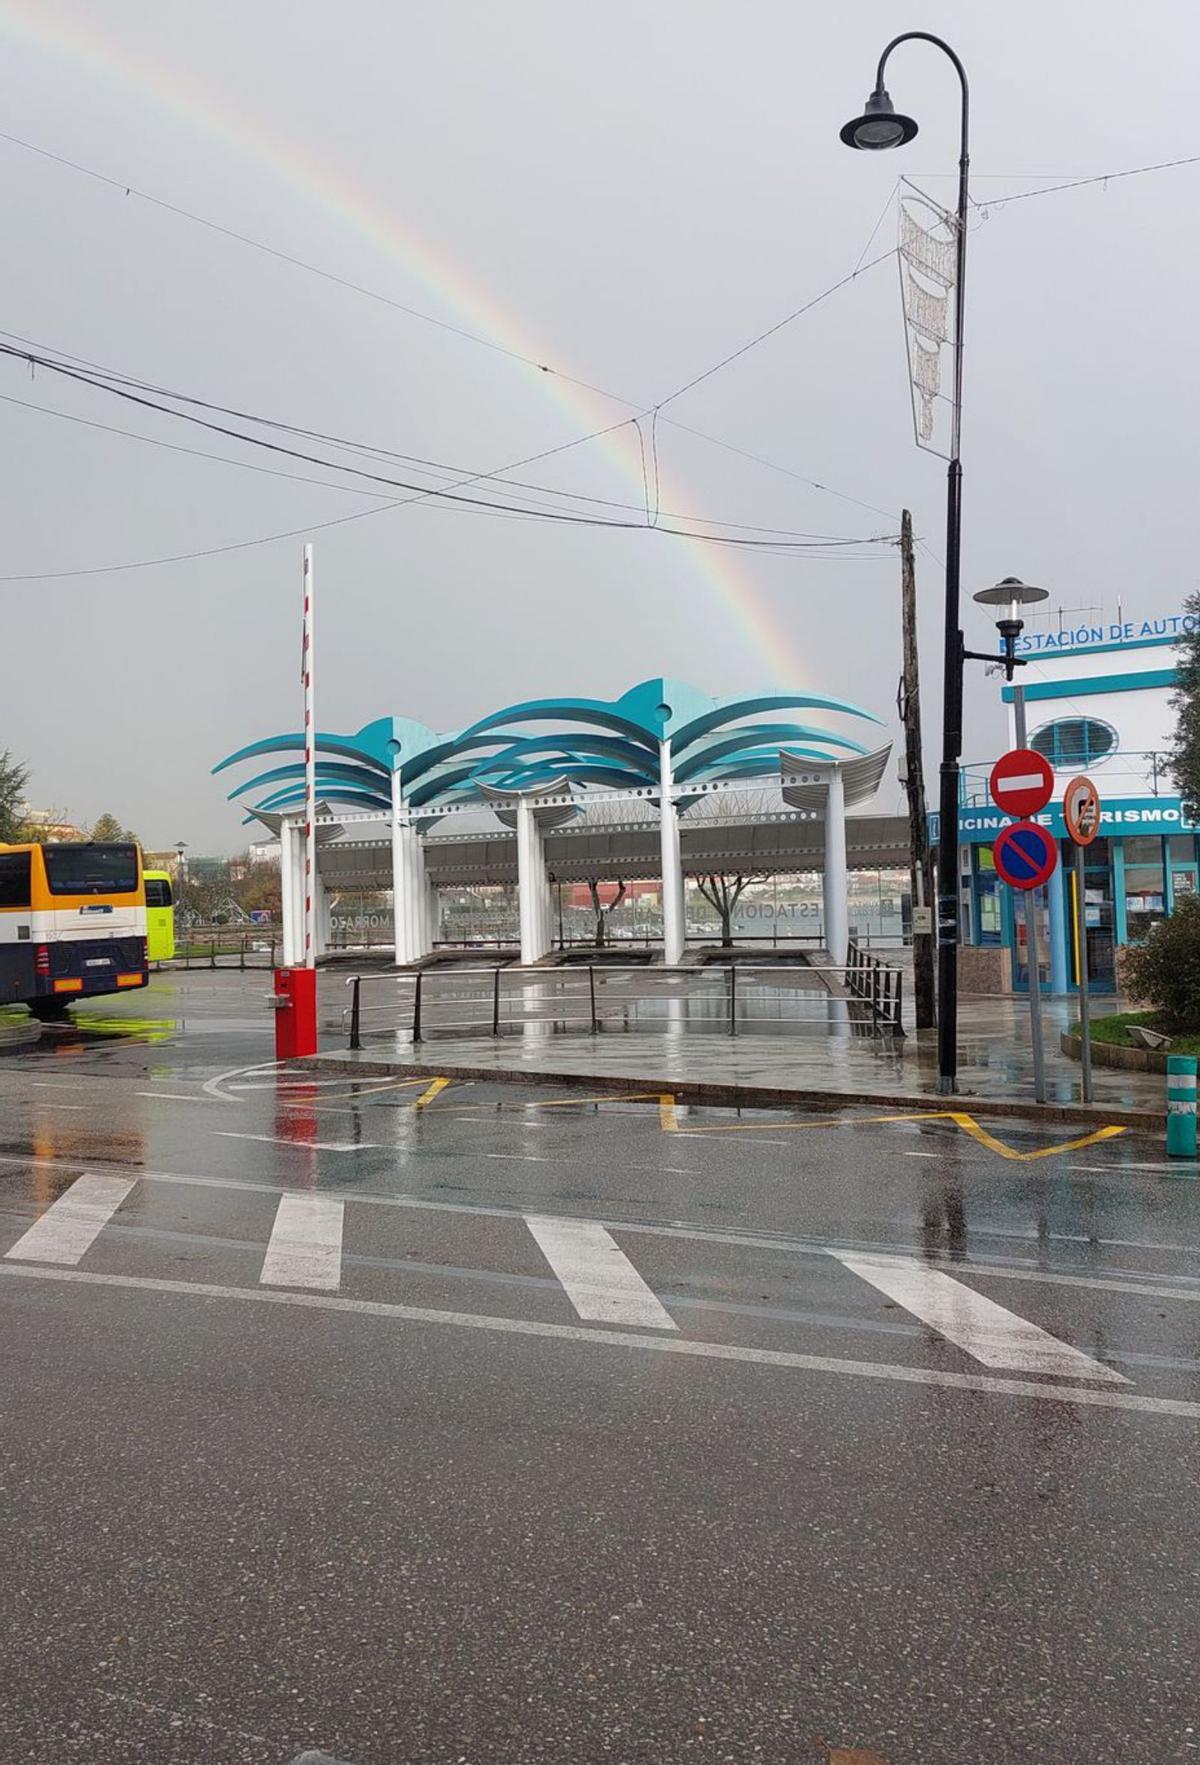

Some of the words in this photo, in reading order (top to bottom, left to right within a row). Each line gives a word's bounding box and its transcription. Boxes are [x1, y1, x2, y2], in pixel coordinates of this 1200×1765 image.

[1012, 624, 1103, 651] ESTACIÓN
[1110, 623, 1134, 640] DE
[1140, 615, 1200, 636] AUTO
[959, 817, 1012, 830] ICINA
